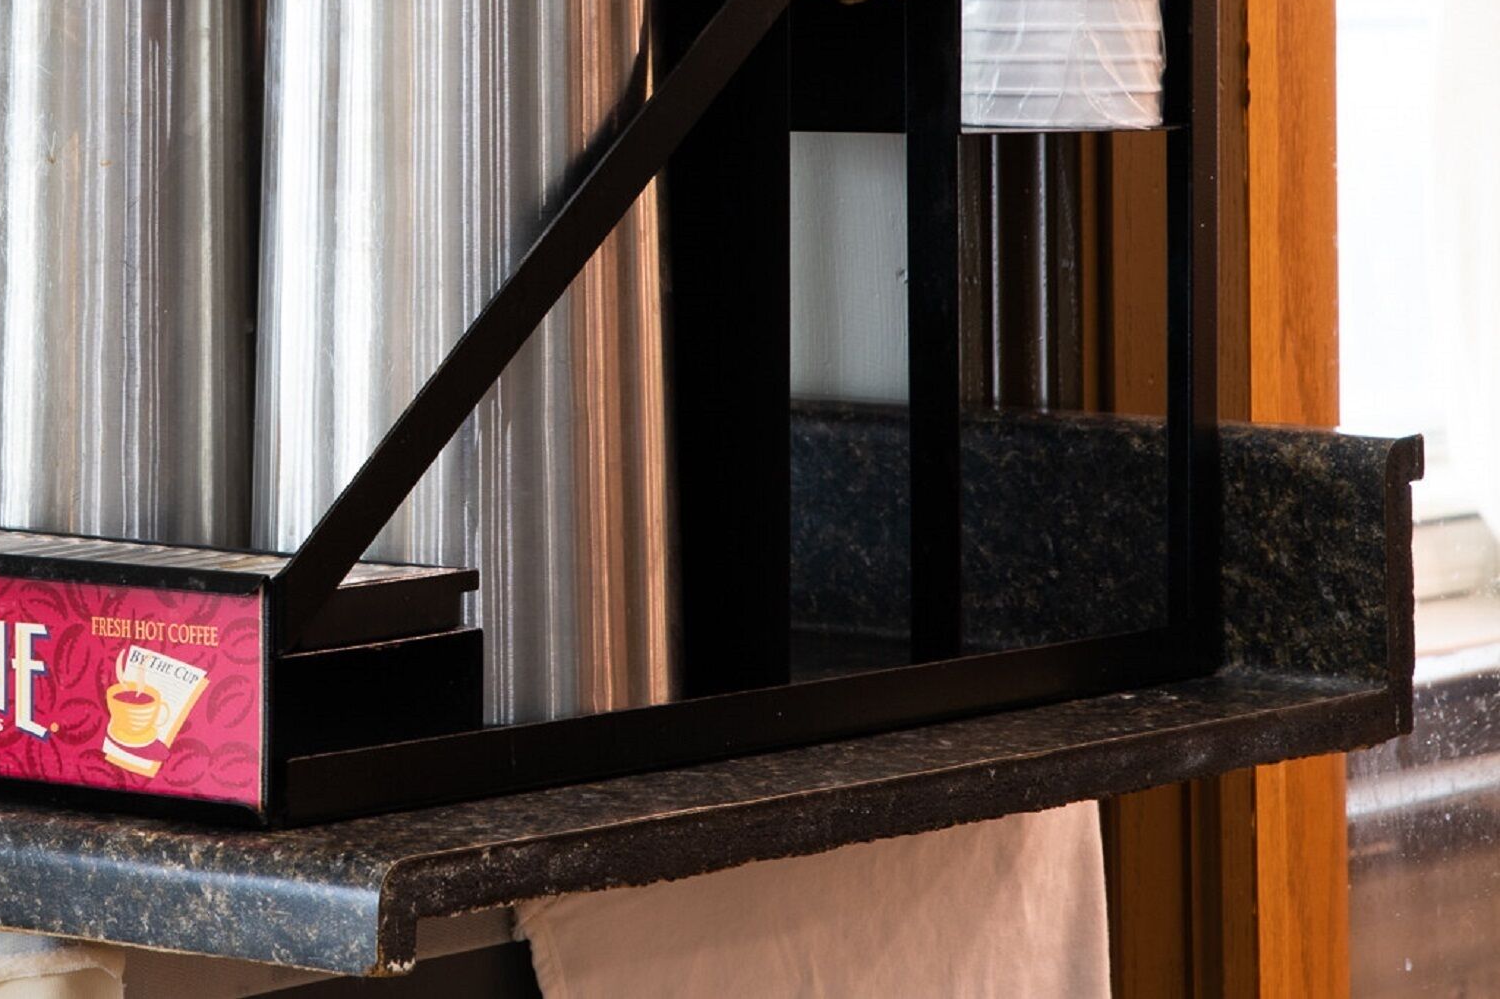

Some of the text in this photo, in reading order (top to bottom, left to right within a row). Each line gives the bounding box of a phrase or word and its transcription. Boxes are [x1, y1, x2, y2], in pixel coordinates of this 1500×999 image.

[91, 616, 220, 647] FRESH HOT COFFEE
